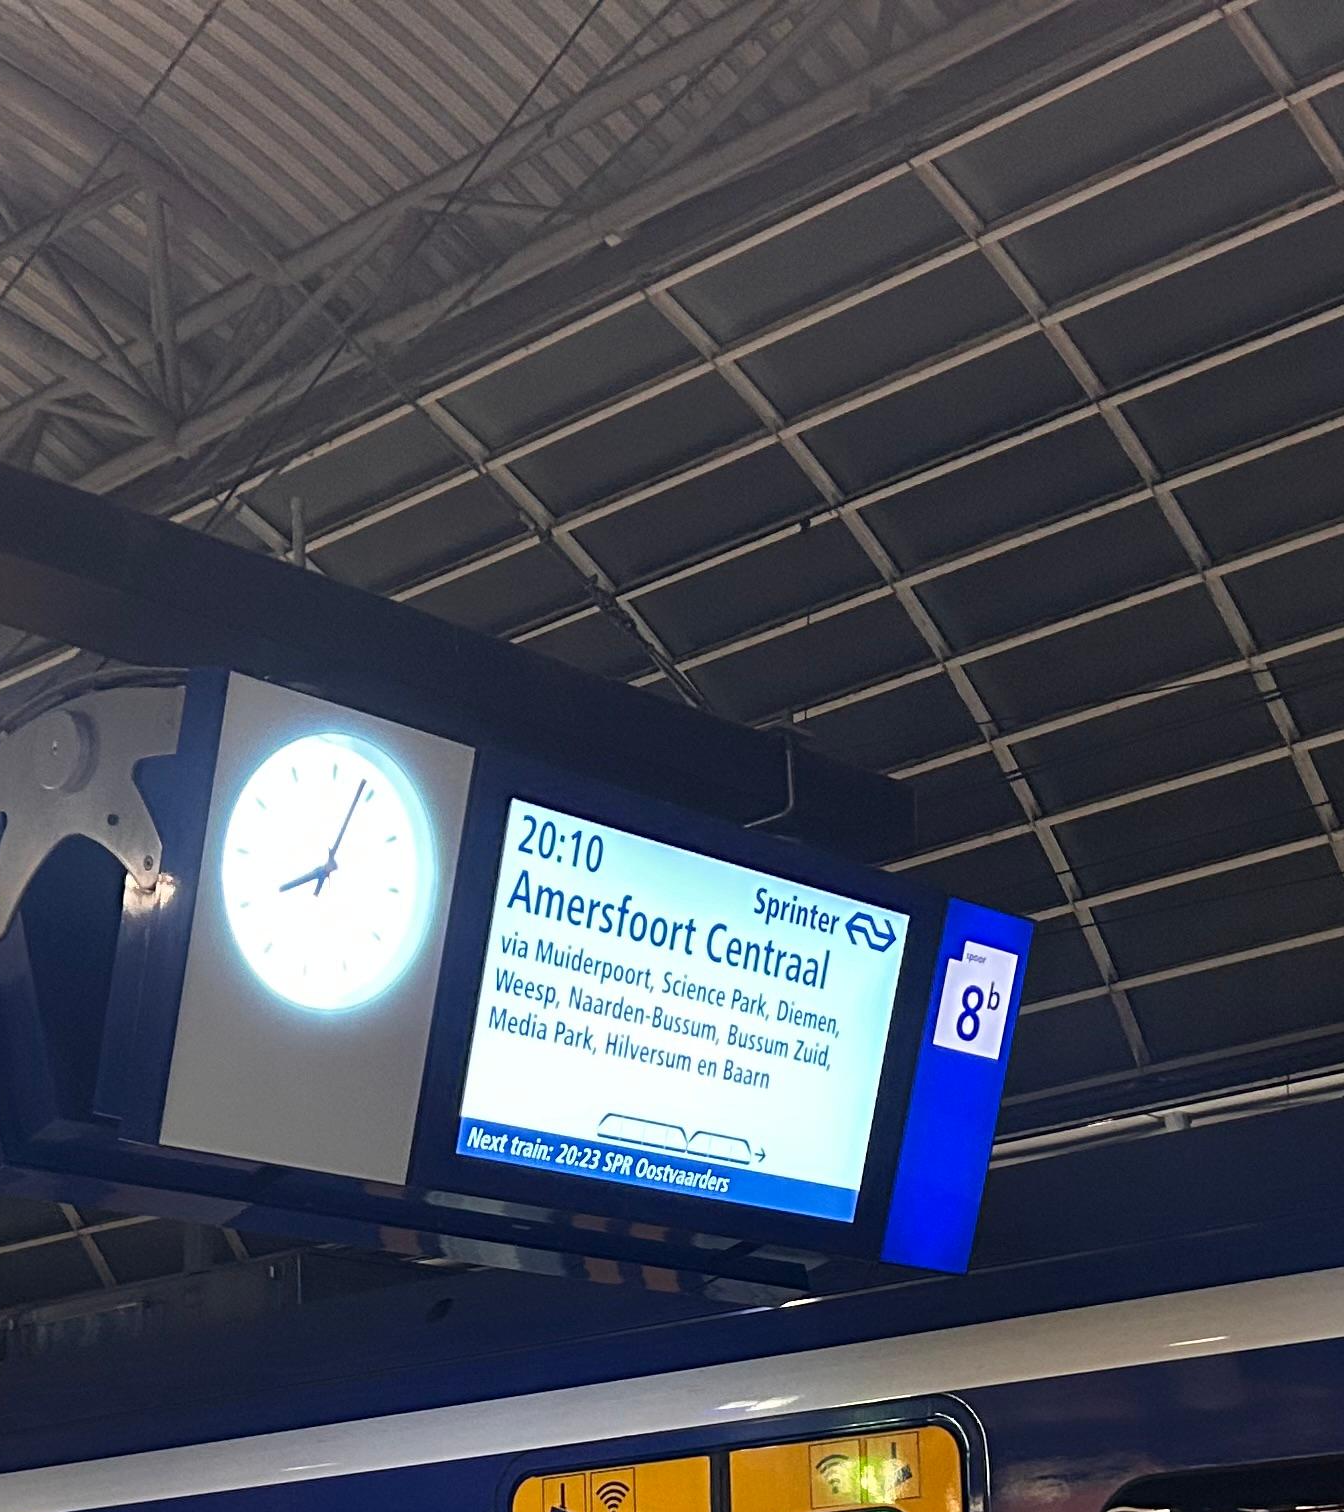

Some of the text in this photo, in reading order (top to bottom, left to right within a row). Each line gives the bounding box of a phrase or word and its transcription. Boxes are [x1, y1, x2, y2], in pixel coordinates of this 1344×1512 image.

[518, 814, 604, 873] 20:10
[507, 869, 831, 989] Amersfoort Centraal
[753, 887, 840, 935] Sprinter
[495, 967, 831, 1071] Weesp, Naarden-Bussum, Bussum Zuid,
[501, 931, 840, 1038] via Muiderpoort, Science Park, Diemen,
[488, 1005, 770, 1090] Media Park, Hilversum en Baarn
[466, 1126, 731, 1193] Next train: 20:23 SPR Oostvaarders
